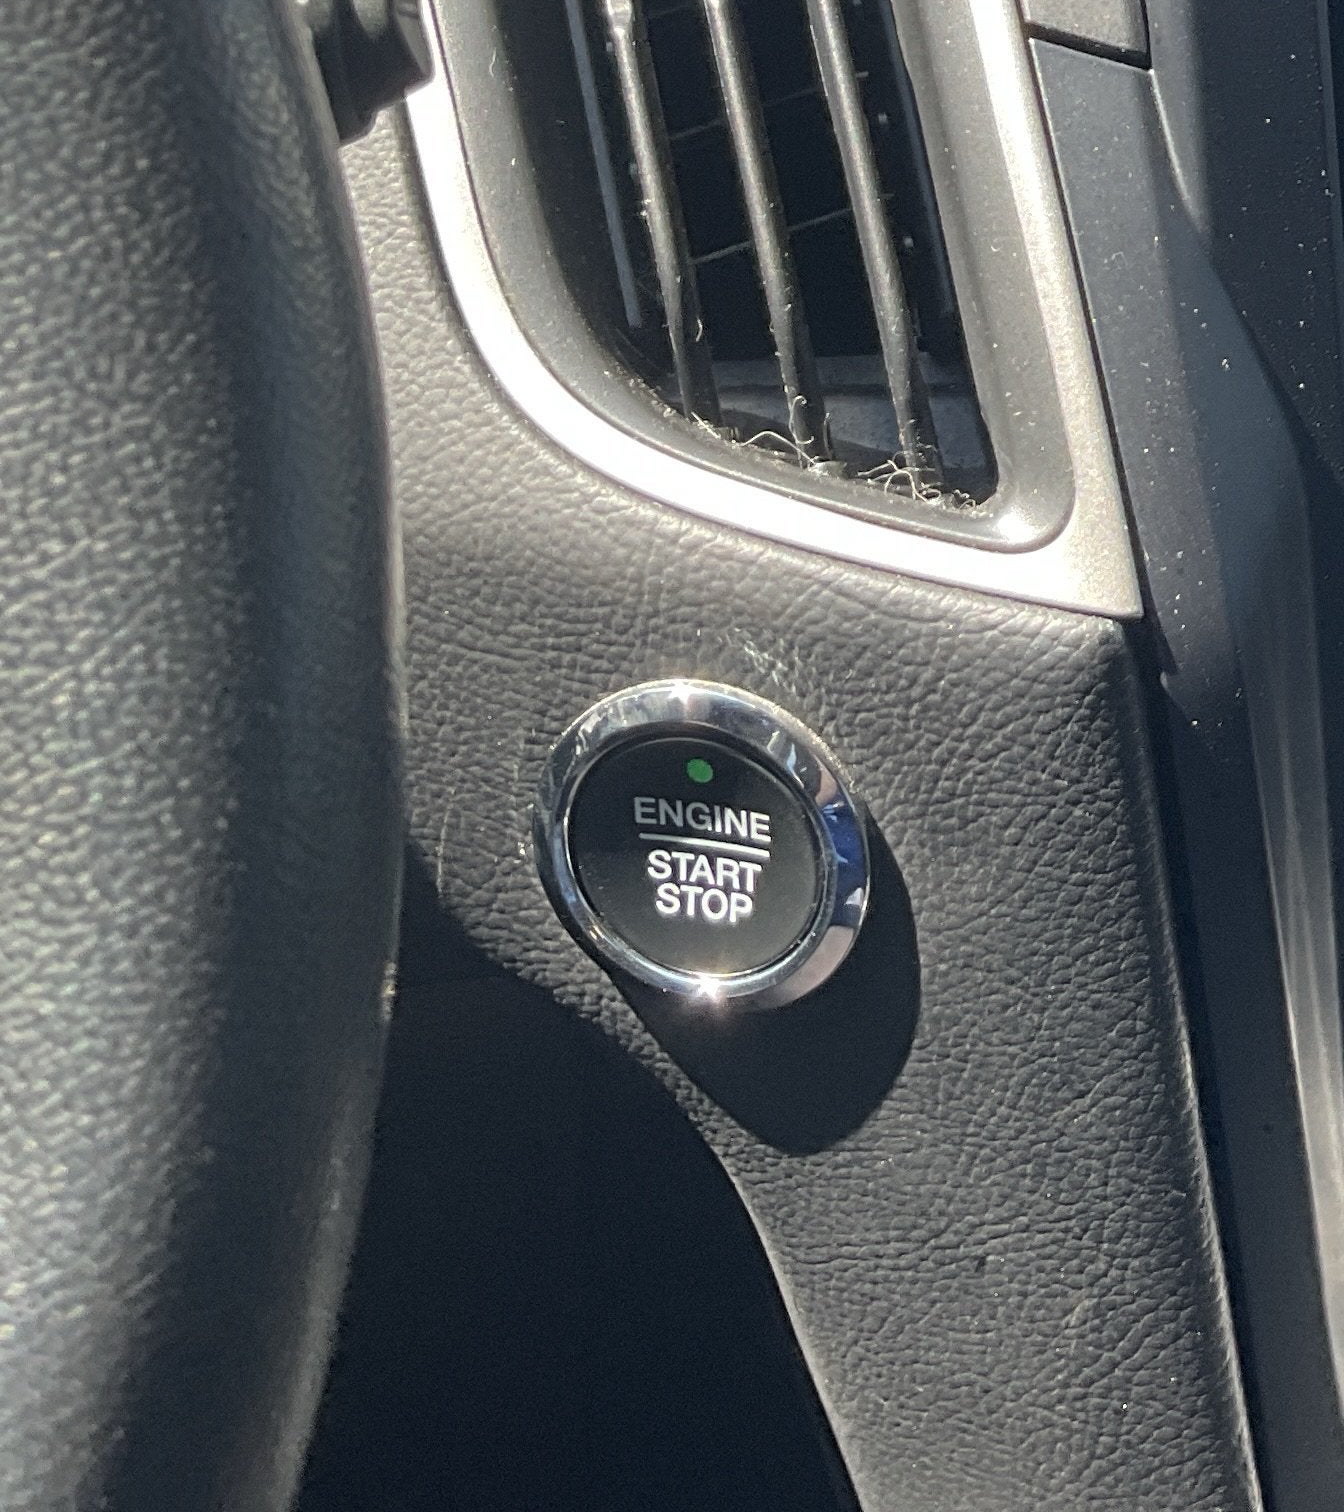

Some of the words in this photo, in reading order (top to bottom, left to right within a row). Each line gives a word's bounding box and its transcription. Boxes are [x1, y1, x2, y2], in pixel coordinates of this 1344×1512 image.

[634, 796, 772, 843] ENGINE
[648, 849, 763, 893] START
[655, 882, 754, 924] STOP
